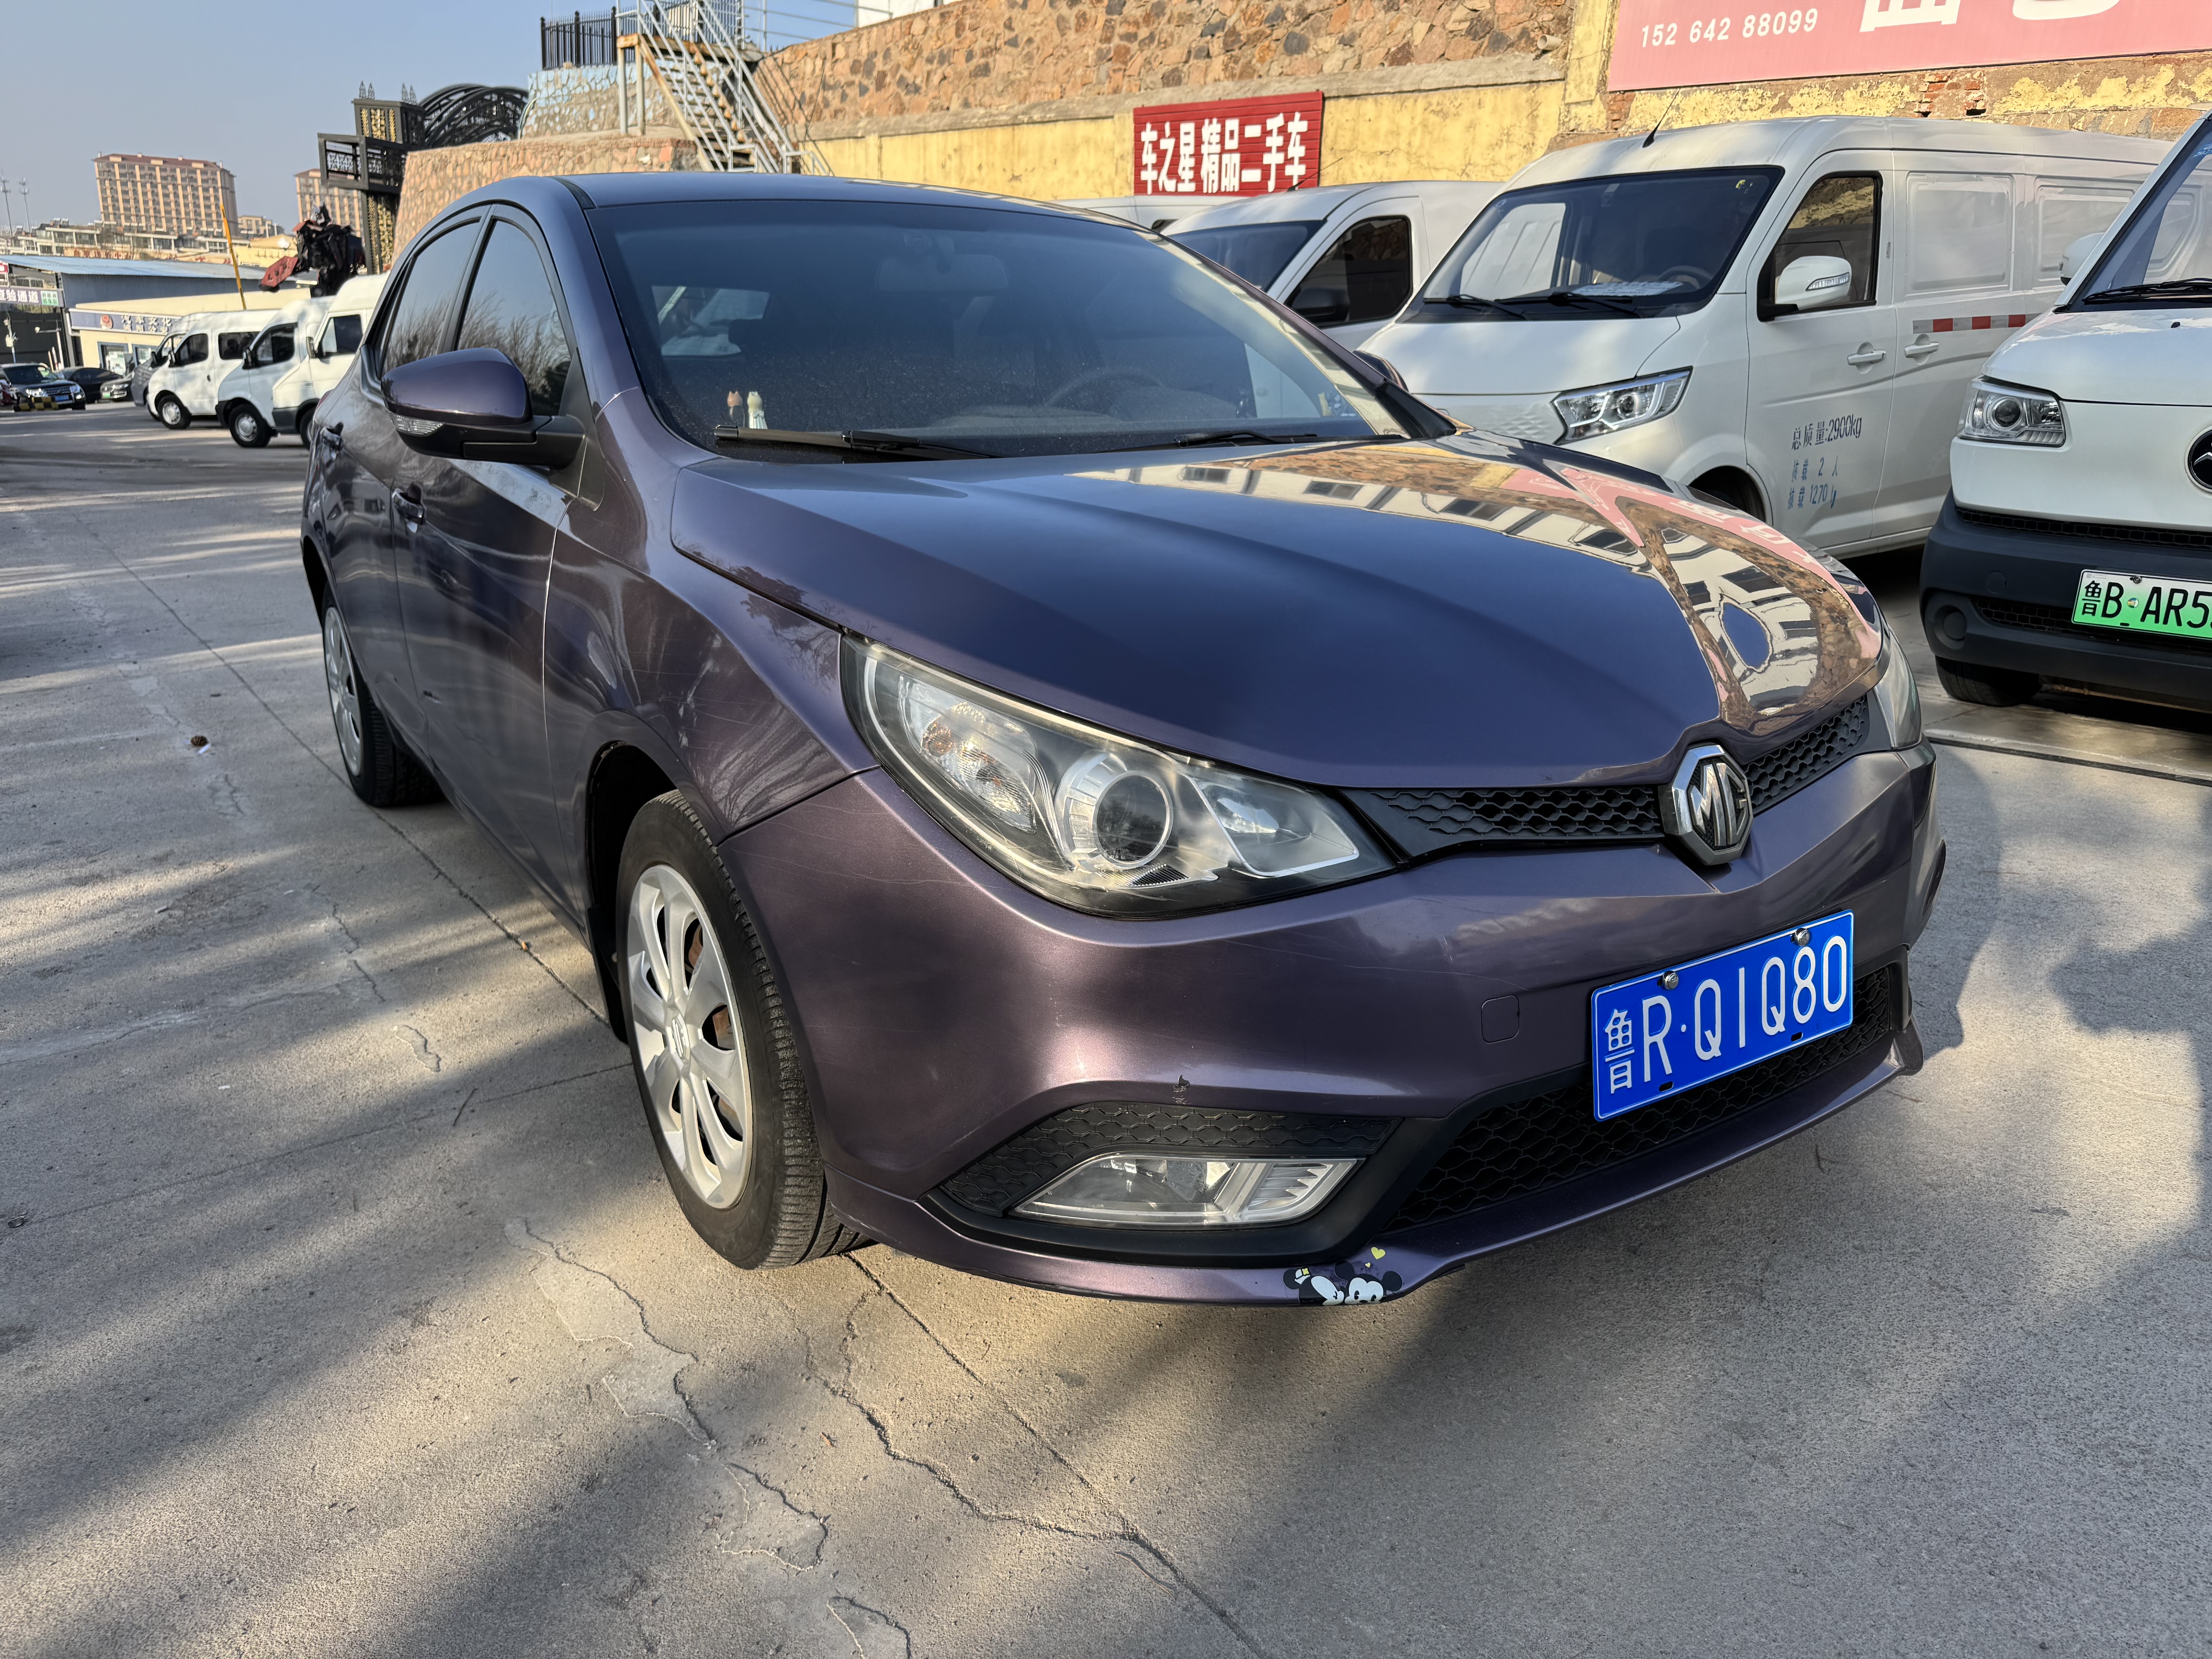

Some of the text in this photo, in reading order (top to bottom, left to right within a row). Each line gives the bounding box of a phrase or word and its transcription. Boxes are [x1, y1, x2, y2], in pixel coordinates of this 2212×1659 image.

[1642, 8, 1818, 48] 152 642 88099
[1140, 111, 1308, 195] 车之星精品二手车
[1791, 414, 1862, 450] 总质量:2900kg
[1690, 763, 1748, 846] MG
